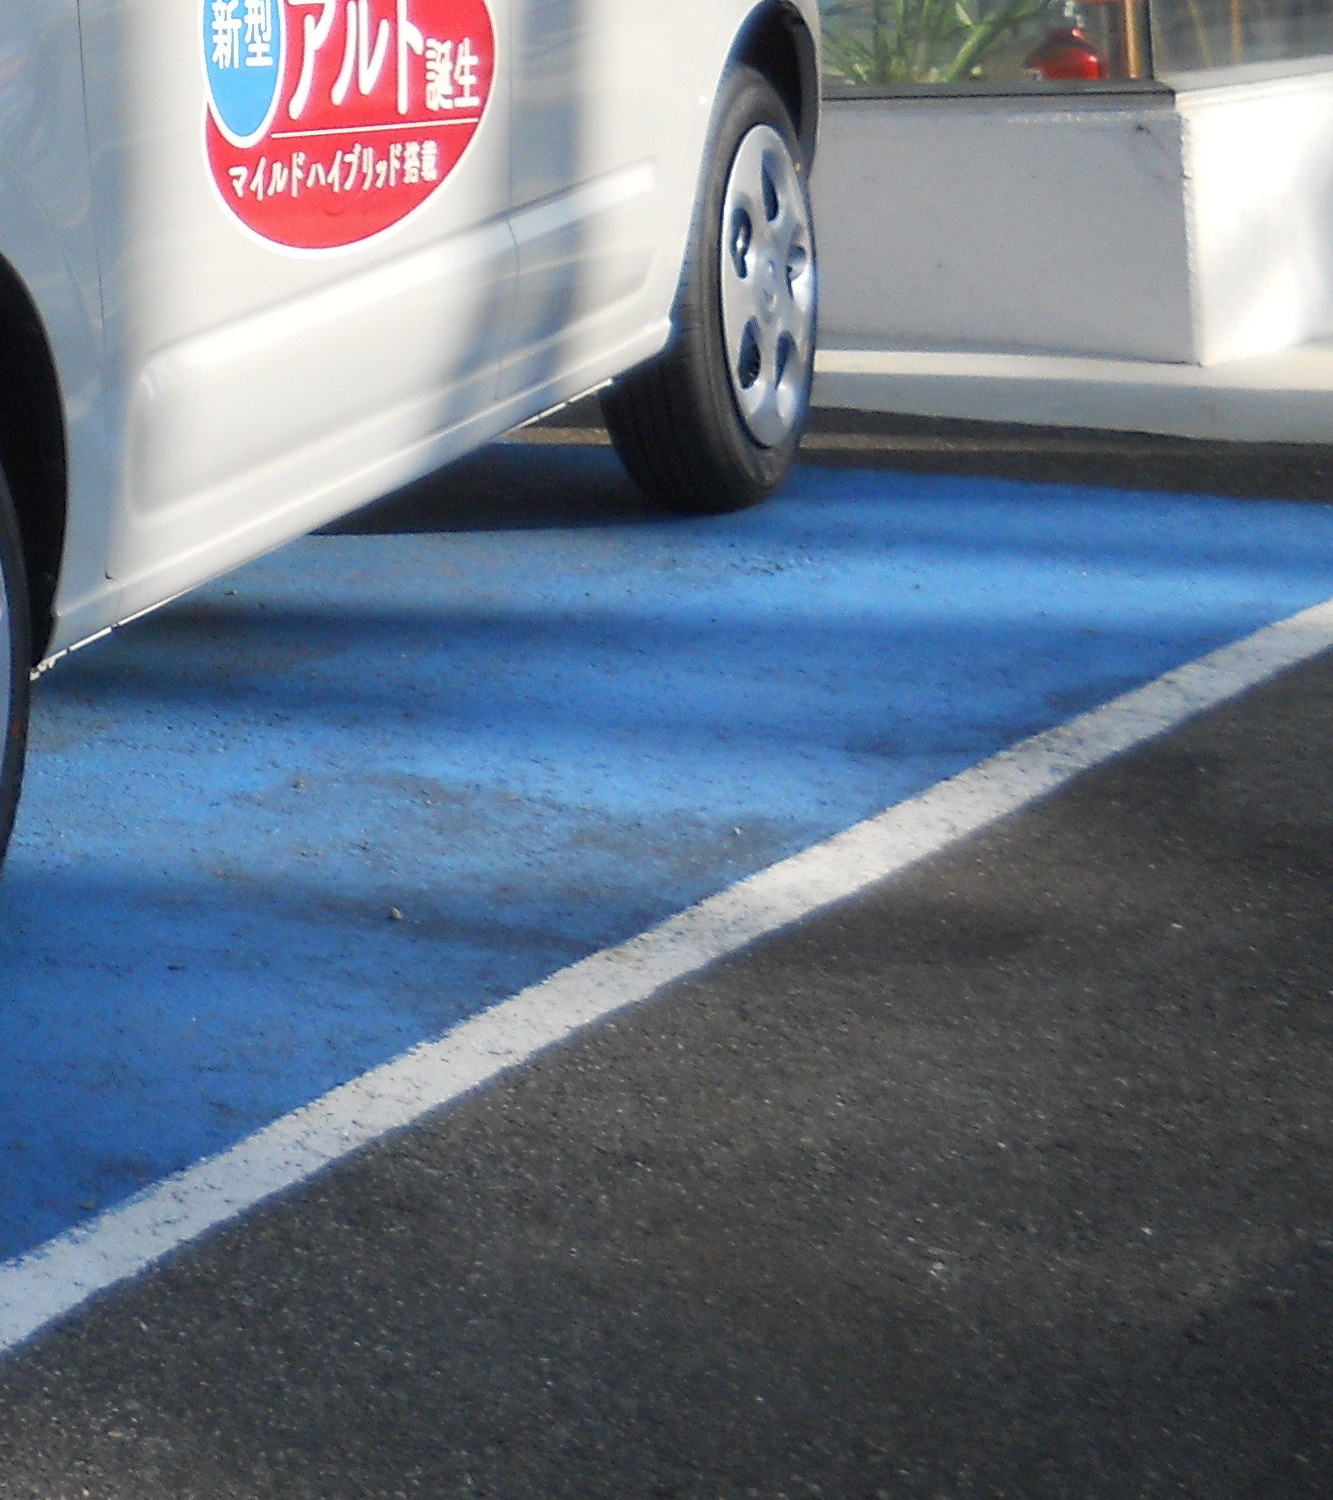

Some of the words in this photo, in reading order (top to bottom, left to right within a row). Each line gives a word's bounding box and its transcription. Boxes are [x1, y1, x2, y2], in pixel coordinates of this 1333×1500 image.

[228, 140, 438, 202] マイルドハイブリッド搭載
